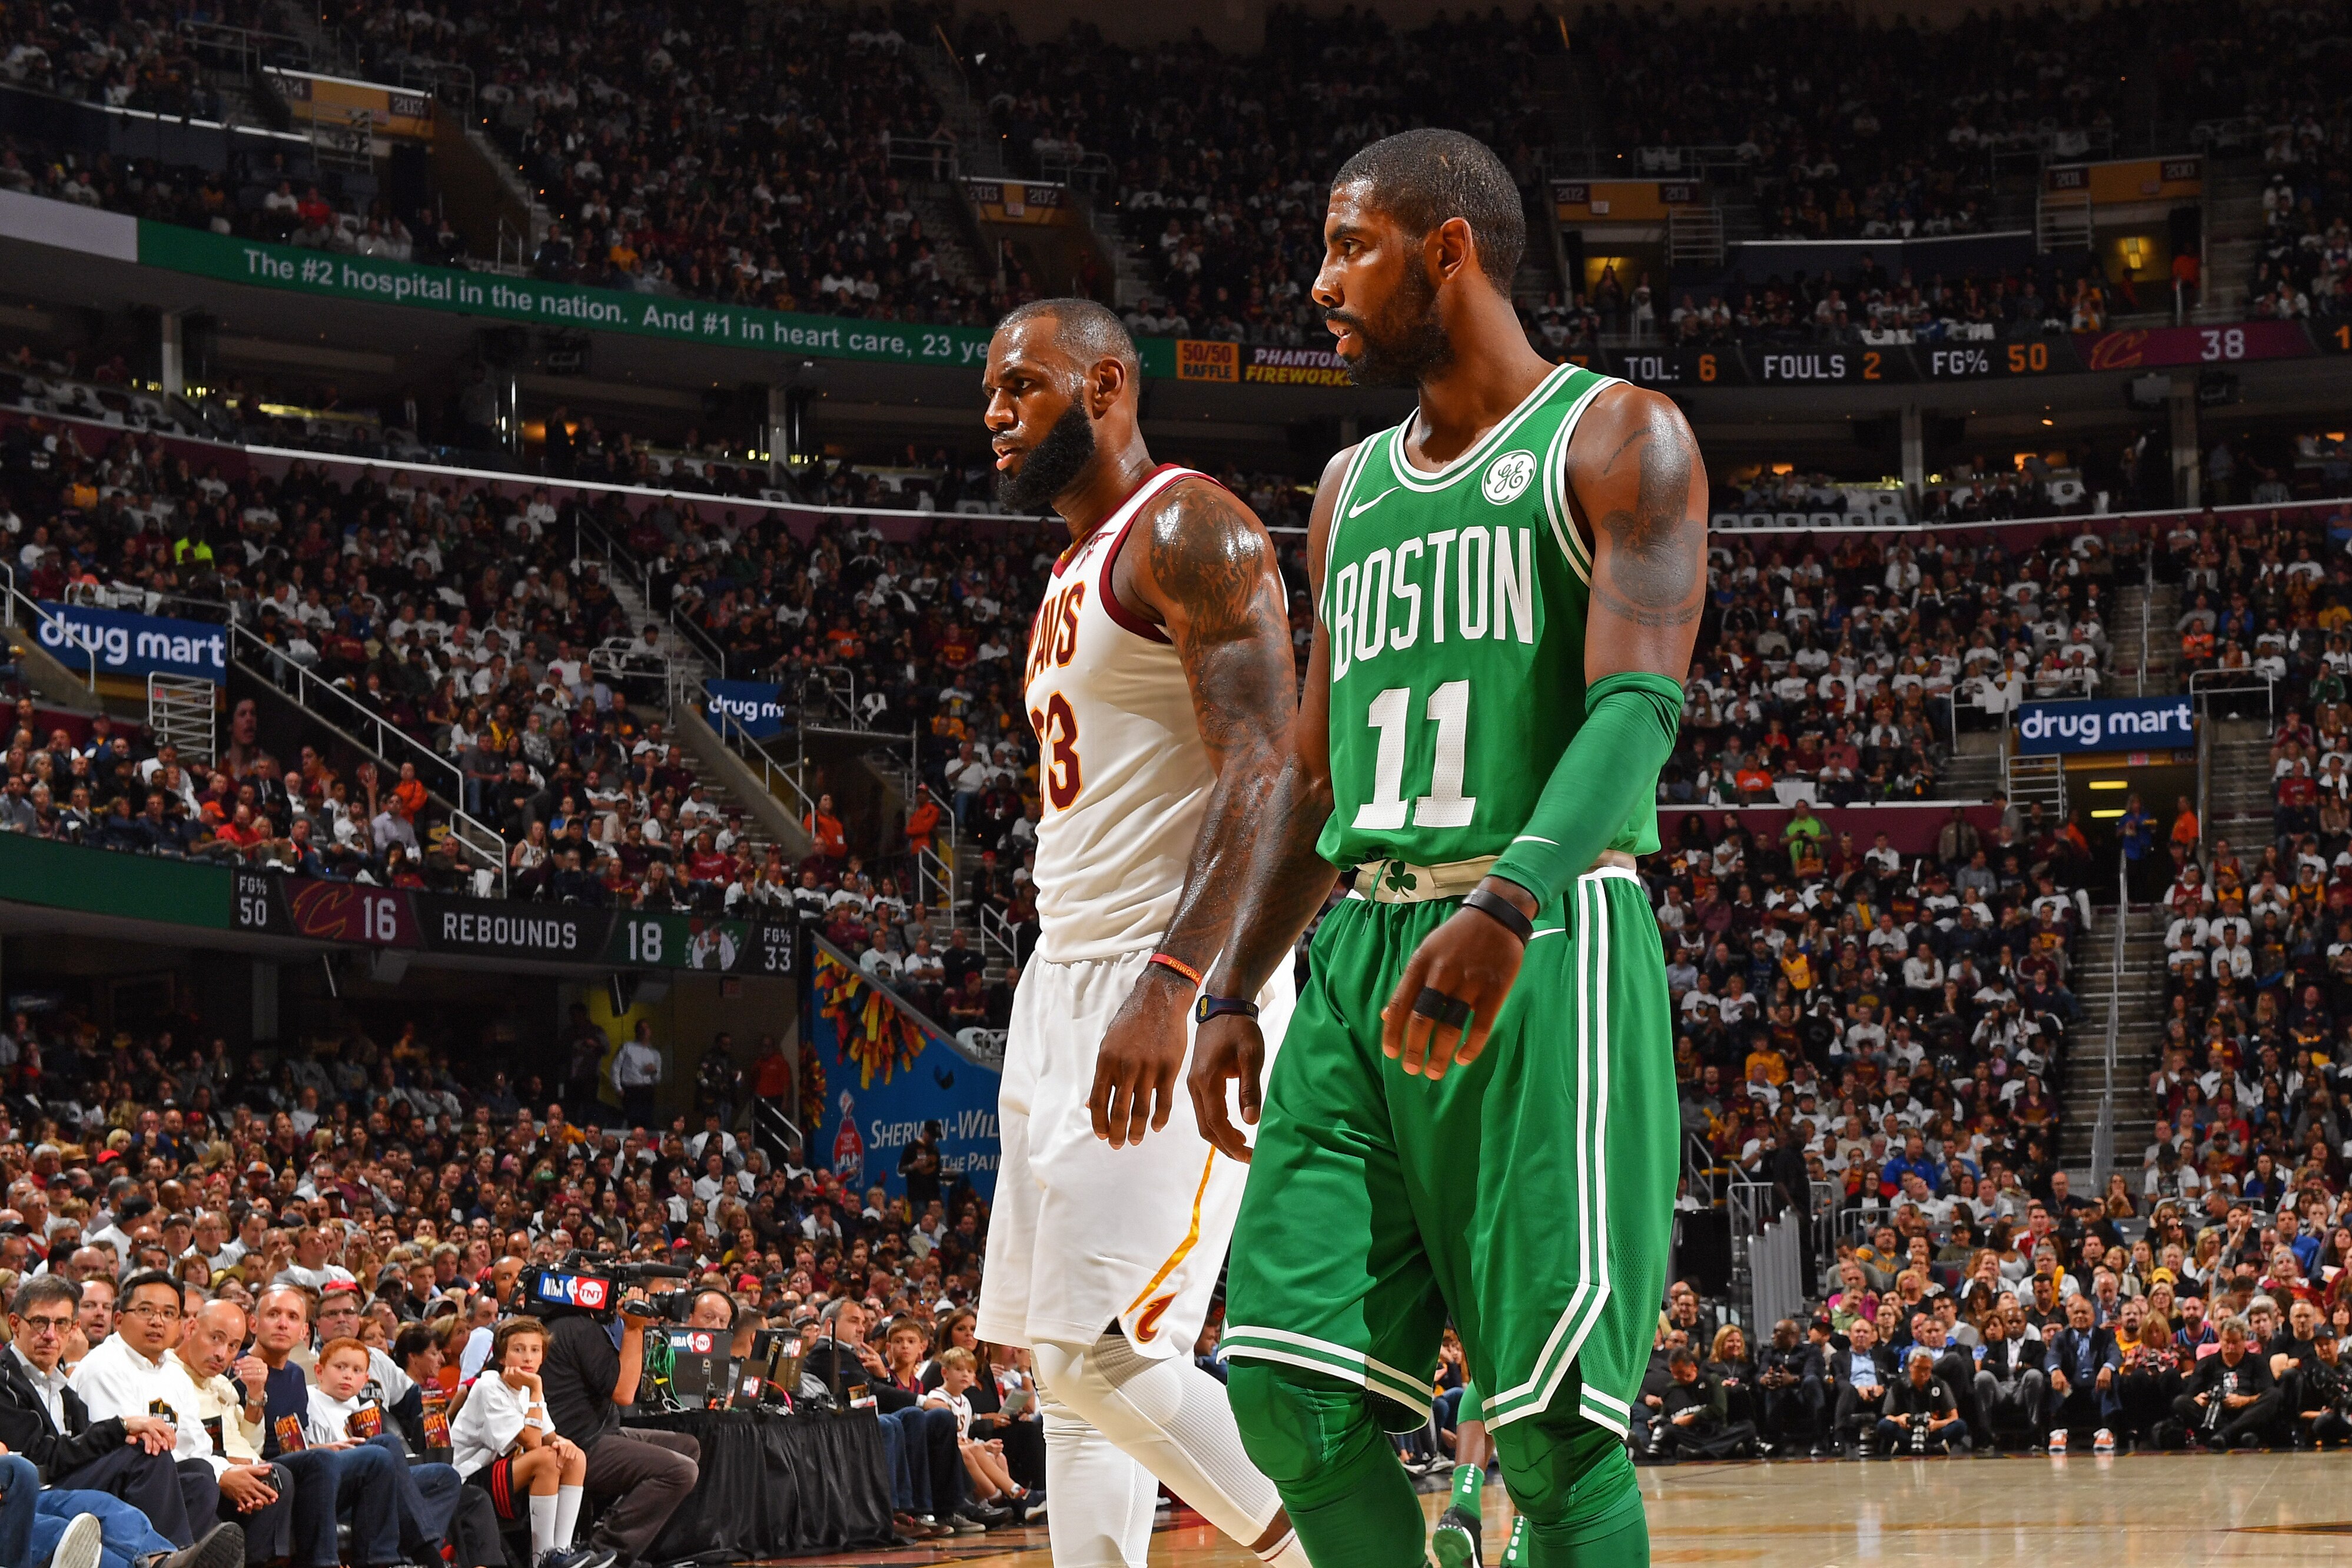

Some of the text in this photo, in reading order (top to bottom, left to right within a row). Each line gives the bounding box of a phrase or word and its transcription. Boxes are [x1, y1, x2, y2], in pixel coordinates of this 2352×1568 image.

[244, 248, 294, 280] The
[302, 257, 333, 286] #2
[343, 264, 451, 301] hospital
[460, 278, 483, 304] in
[492, 285, 532, 311] the
[540, 295, 627, 324] nation.
[643, 305, 694, 332] And
[703, 311, 730, 337] #1
[742, 317, 763, 341] in
[774, 321, 840, 349] heart
[849, 333, 912, 358] care,
[922, 334, 951, 356] 23
[1182, 343, 1231, 363] 50/50
[1933, 344, 2047, 375] FG% 50
[2201, 330, 2245, 361] 38
[1183, 364, 1231, 379] RAFFLE
[1625, 354, 1717, 381] TOL: 6
[1765, 353, 1881, 380] FOULS 2
[1333, 526, 1534, 683] BOSTON
[39, 611, 226, 668] drug mart
[1025, 580, 1086, 691] AVS
[709, 693, 758, 723] drug
[2021, 703, 2192, 746] drug mart
[1351, 679, 1476, 830] 11
[239, 875, 267, 895] FG%
[240, 896, 267, 926] 50
[364, 895, 397, 941] 16
[443, 912, 577, 950] REBOUNDS
[628, 920, 663, 962] 18
[763, 927, 791, 945] FG%
[765, 946, 791, 971] 33
[1167, 958, 1201, 982] PROMISE
[543, 1277, 602, 1300] NBA TNT
[670, 1336, 687, 1347] NBA
